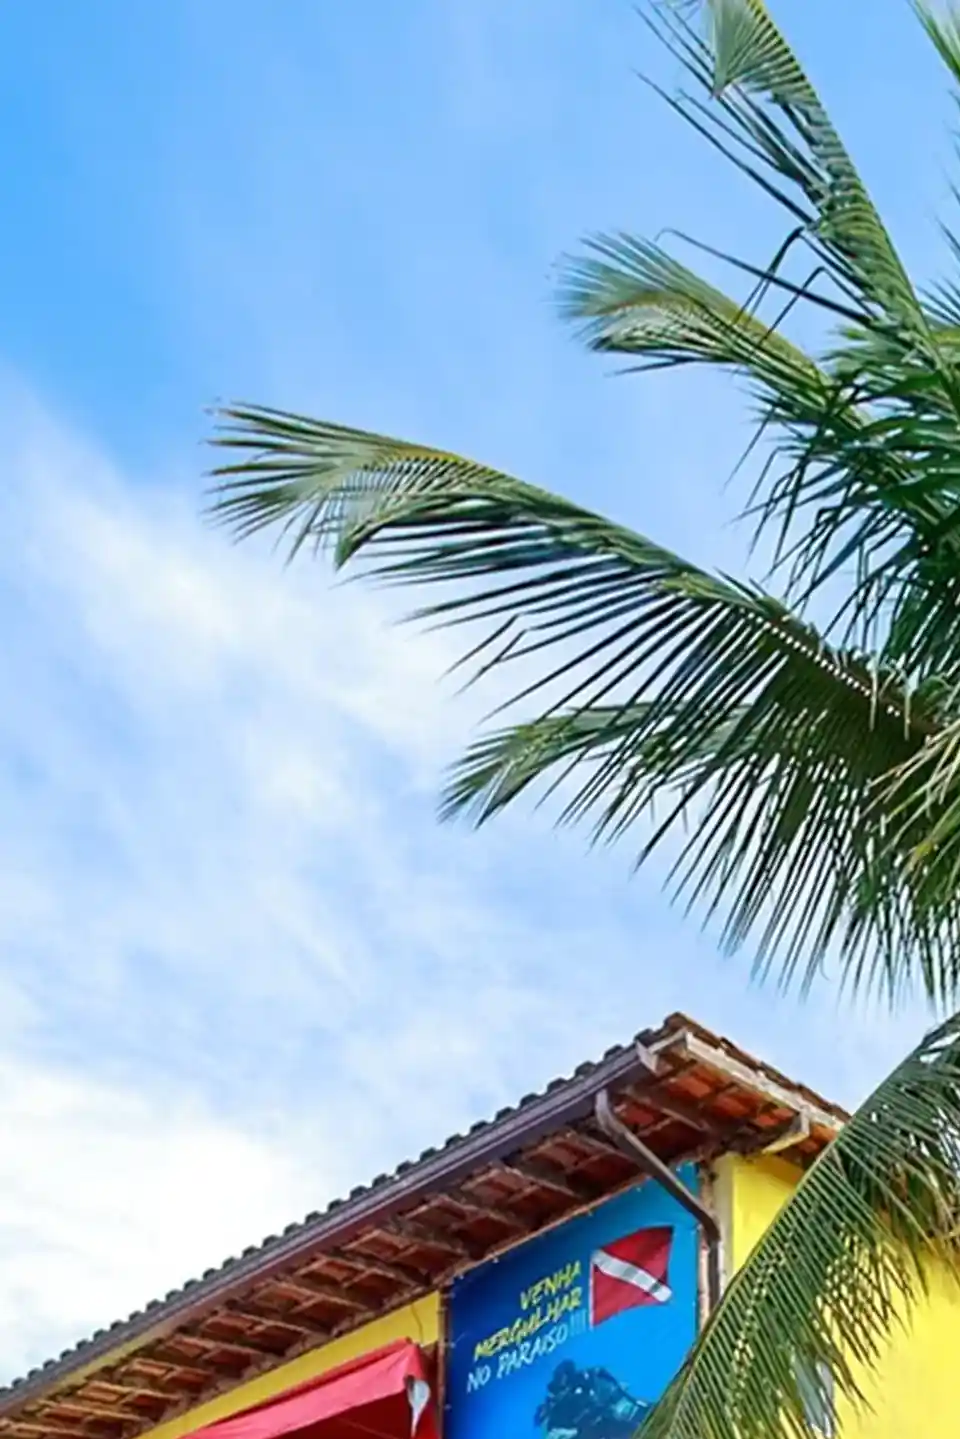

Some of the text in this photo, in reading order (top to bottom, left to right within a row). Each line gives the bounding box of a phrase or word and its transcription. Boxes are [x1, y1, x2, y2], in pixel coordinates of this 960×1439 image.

[520, 1260, 582, 1311] VENHA
[473, 1286, 583, 1362] MERGULHAR
[467, 1365, 491, 1393] NO
